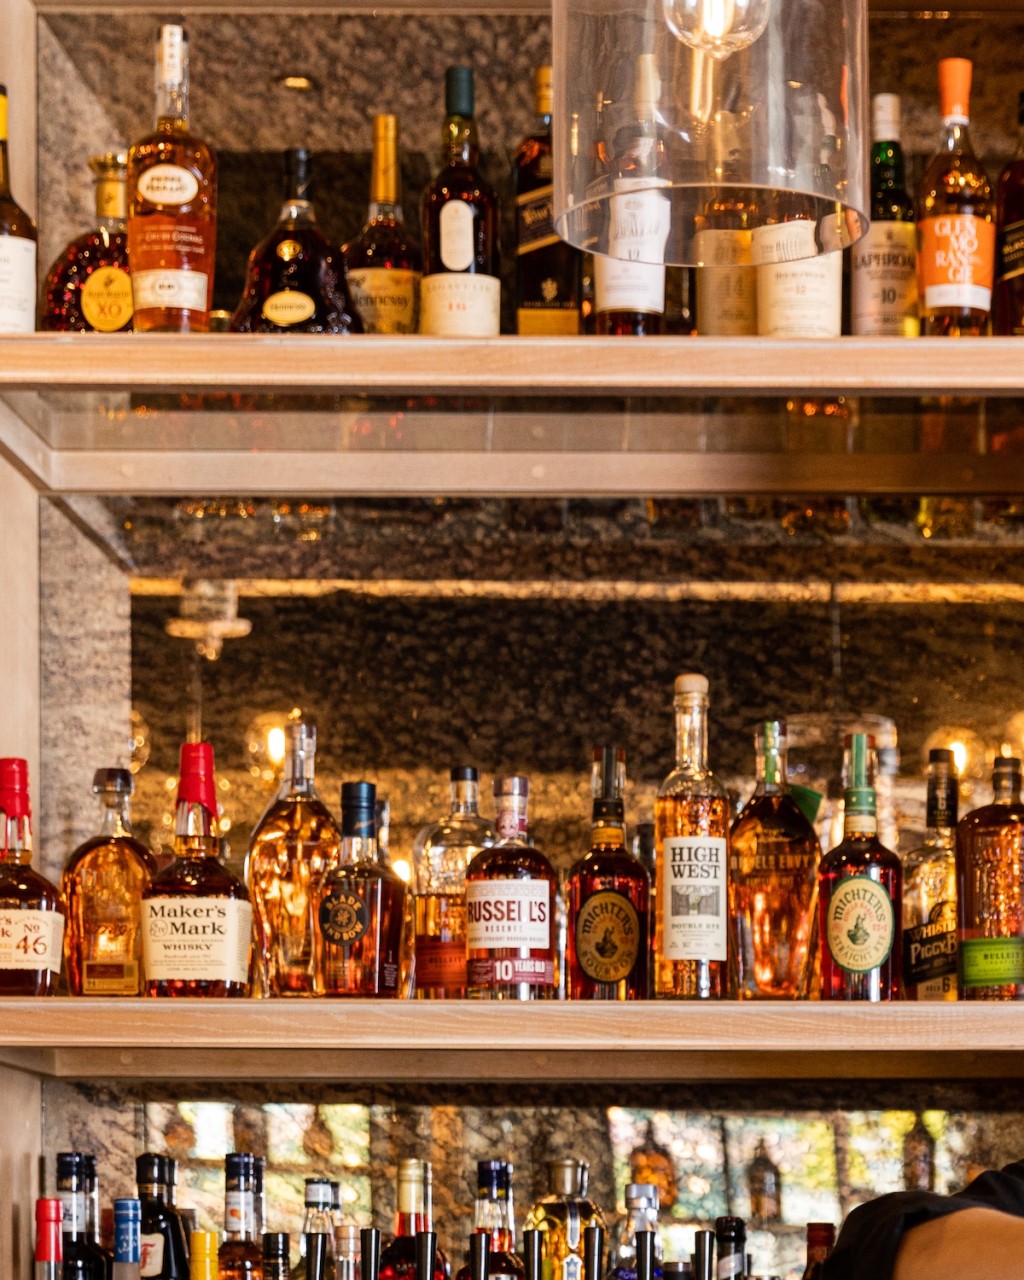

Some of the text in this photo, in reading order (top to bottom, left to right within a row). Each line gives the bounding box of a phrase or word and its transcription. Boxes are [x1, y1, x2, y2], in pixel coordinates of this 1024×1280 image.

[934, 219, 977, 237] GLEN
[951, 236, 979, 252] MO
[881, 287, 897, 304] 10
[98, 302, 122, 318] XO
[671, 847, 720, 863] HIGH
[671, 864, 720, 879] WEST
[325, 894, 362, 911] BLADE
[834, 889, 887, 923] MICHTER'S
[149, 904, 227, 919] Maker's
[582, 902, 634, 936] MICHTER'S
[169, 922, 225, 936] Mark
[342, 921, 364, 941] BOW
[16, 935, 47, 956] 46
[494, 960, 513, 981] 10
[514, 960, 535, 973] YEARS
[942, 977, 951, 992] 6
